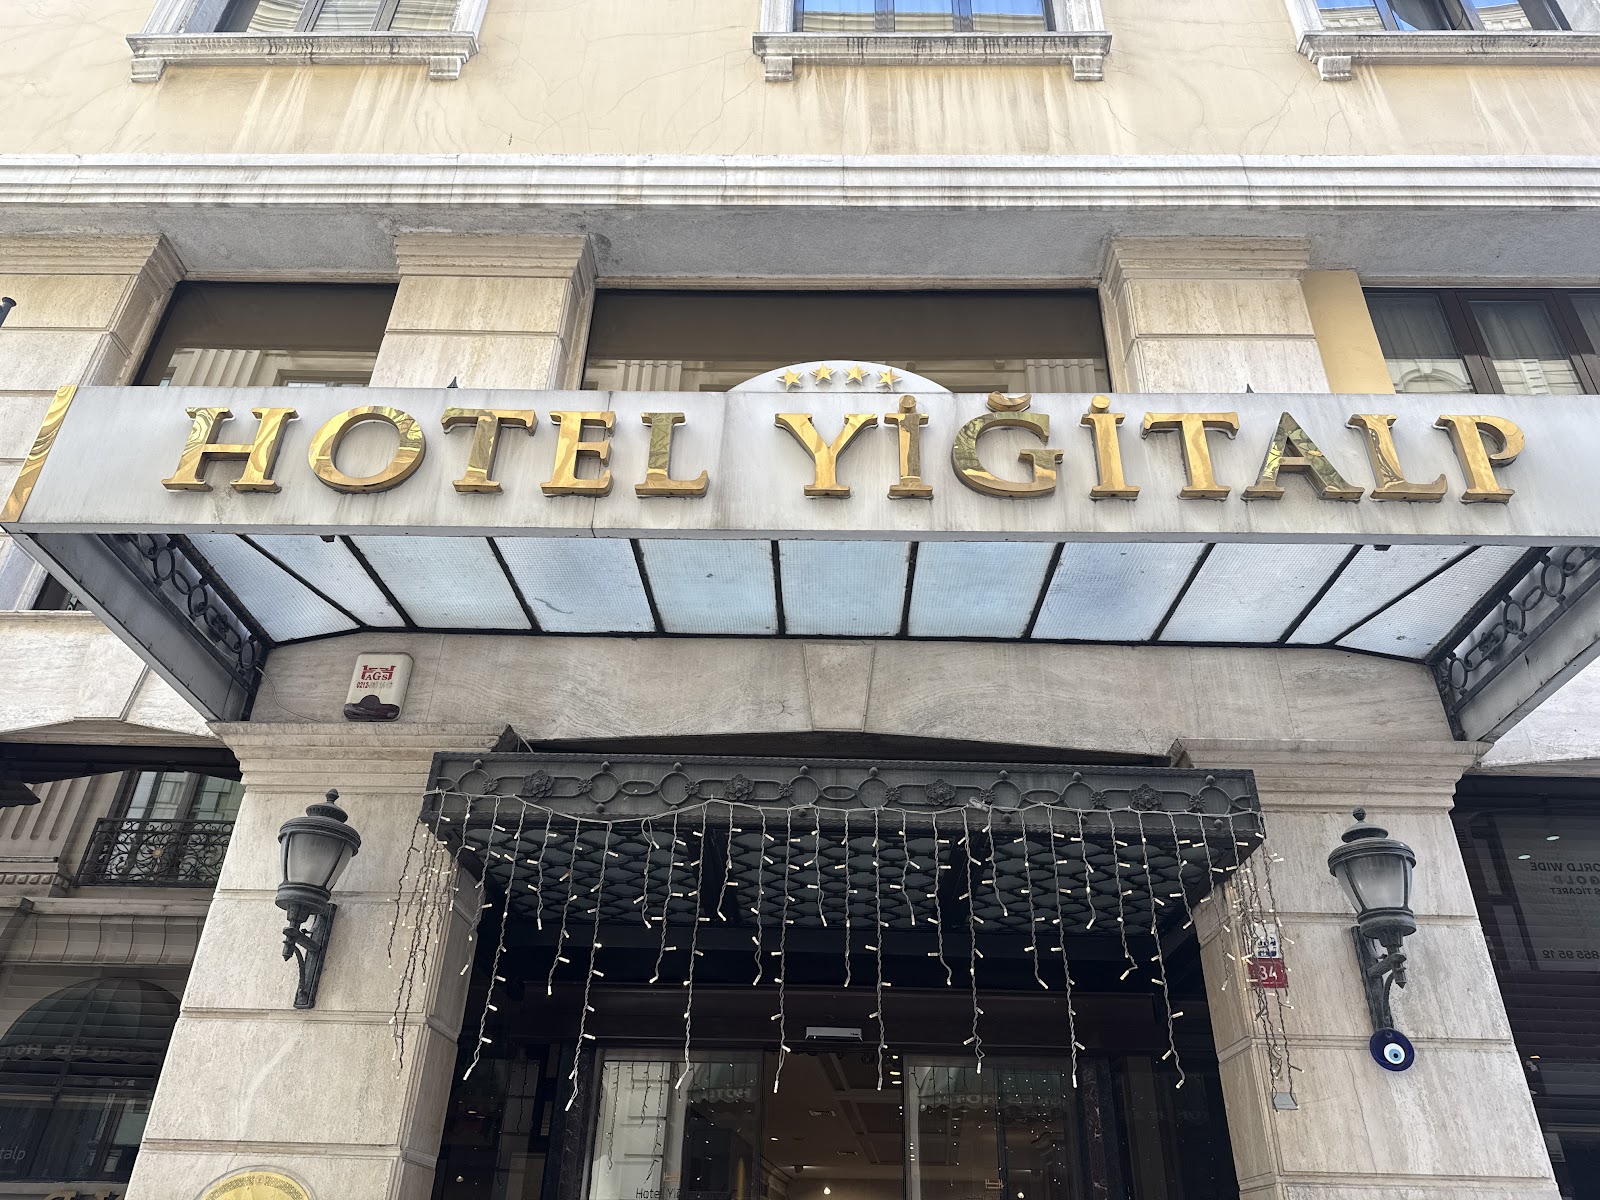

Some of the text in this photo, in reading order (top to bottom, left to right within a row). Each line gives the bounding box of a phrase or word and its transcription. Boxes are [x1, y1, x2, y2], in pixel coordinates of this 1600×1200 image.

[161, 390, 1526, 503] HOTEL YİĞİTALP
[635, 1187, 661, 1199] Hote
